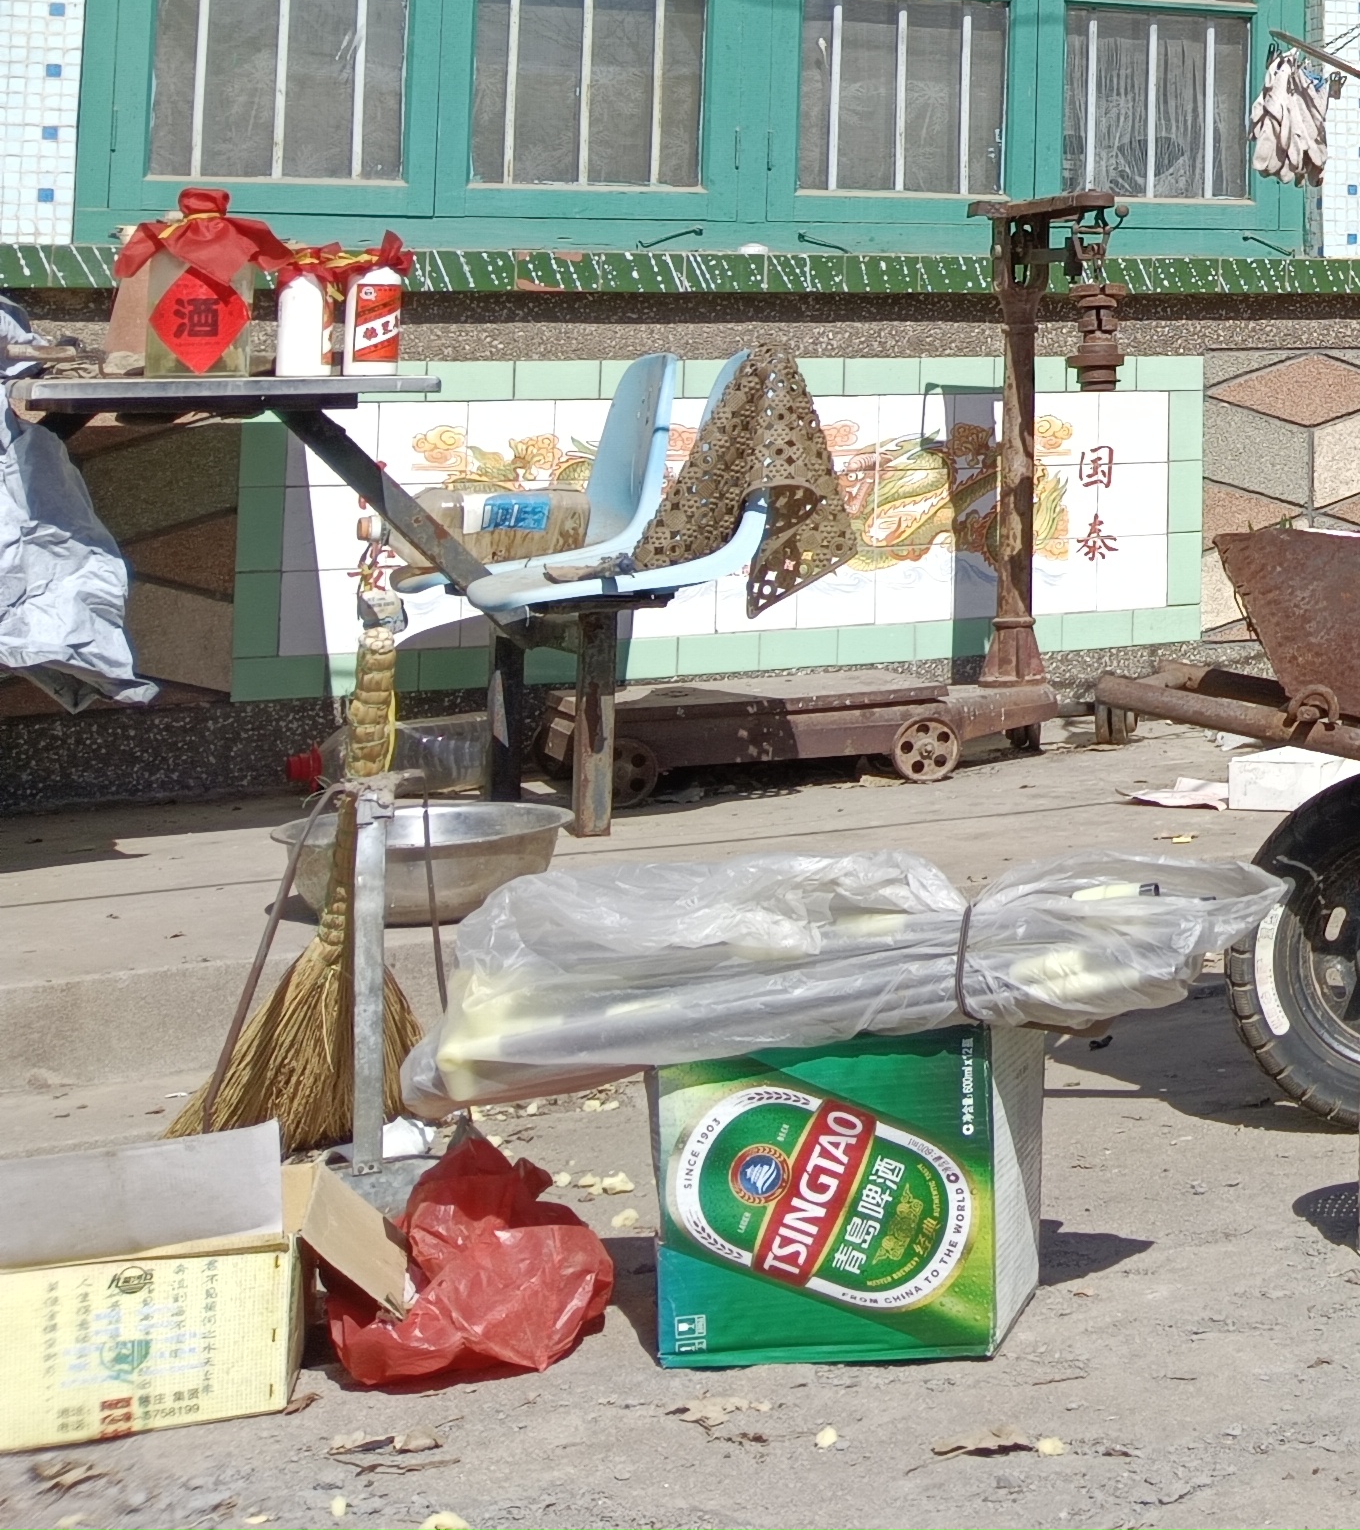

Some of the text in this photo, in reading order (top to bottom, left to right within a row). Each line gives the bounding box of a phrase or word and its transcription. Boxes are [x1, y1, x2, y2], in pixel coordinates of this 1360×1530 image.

[173, 298, 221, 340] 酒
[1075, 445, 1119, 562] 国泰
[683, 1117, 721, 1190] SINCE 1903
[763, 1111, 864, 1275] TSINGTAO
[841, 1187, 967, 1305] FROM CHINA TO THE WORLD
